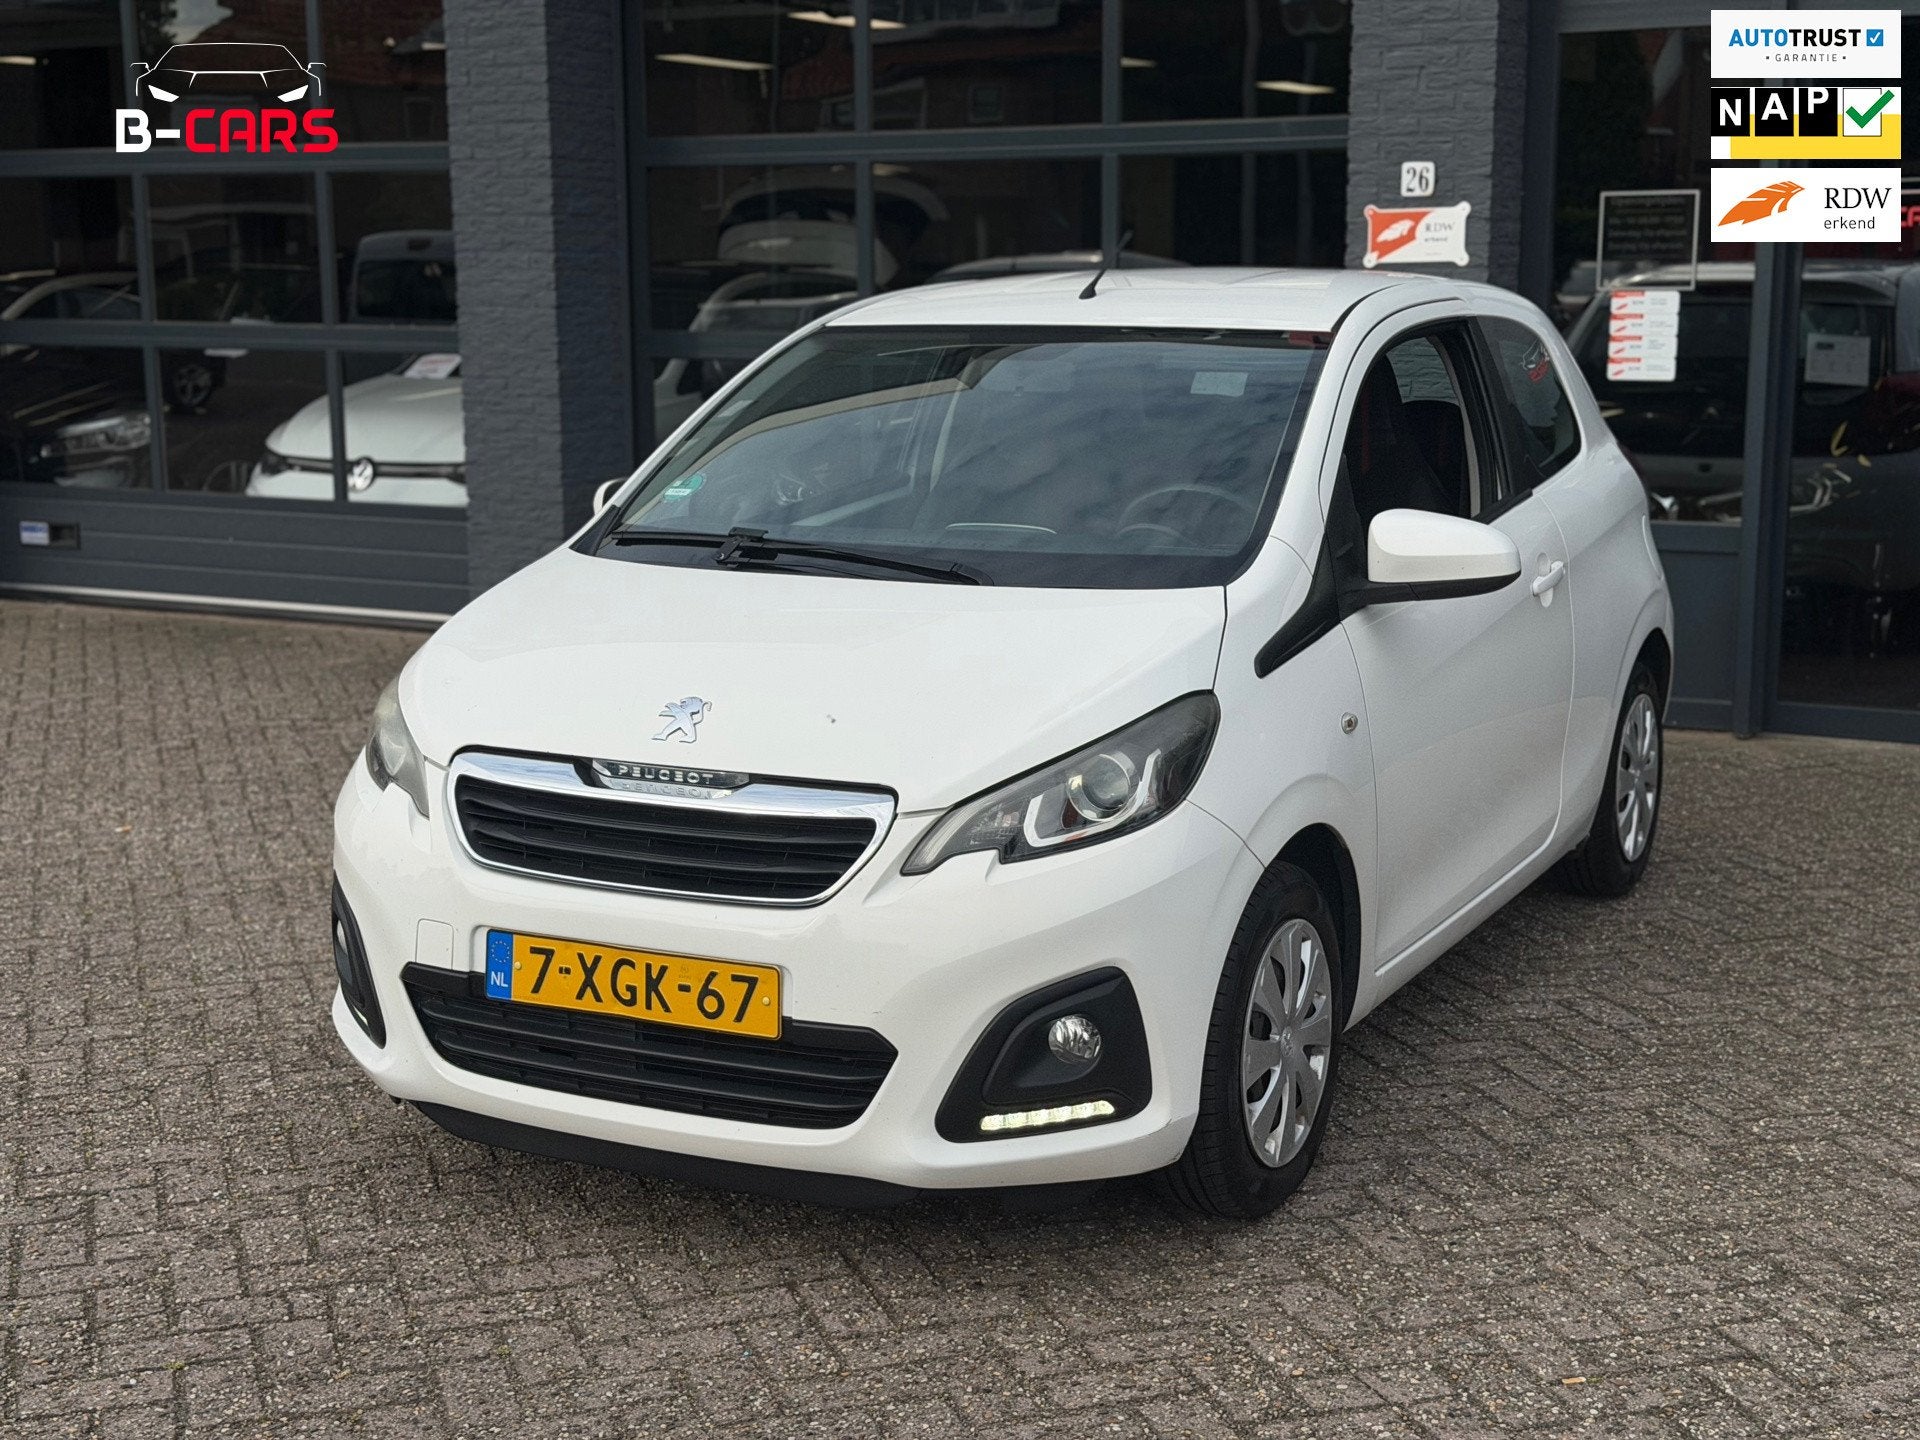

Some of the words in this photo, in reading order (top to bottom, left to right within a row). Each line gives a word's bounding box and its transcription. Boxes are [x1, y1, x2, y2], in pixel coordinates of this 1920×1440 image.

[1406, 167, 1430, 192] 26
[618, 764, 714, 785] PEUGEOT
[490, 971, 509, 988] NL
[529, 946, 760, 1023] 7-XGK-67
